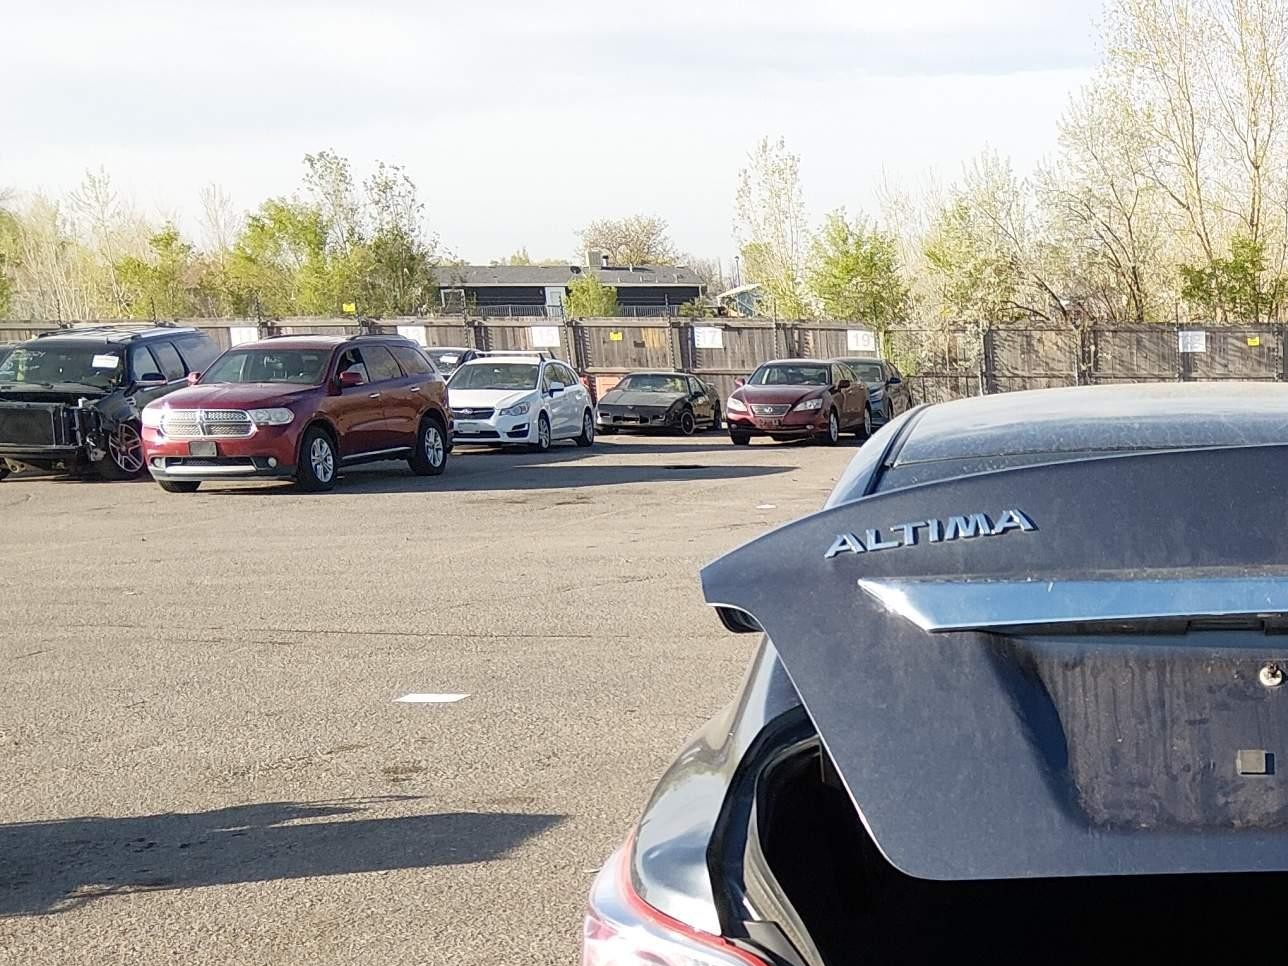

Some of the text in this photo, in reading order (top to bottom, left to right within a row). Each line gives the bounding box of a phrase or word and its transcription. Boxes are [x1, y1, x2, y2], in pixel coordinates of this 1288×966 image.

[702, 330, 717, 345] 17
[854, 333, 870, 347] 19
[824, 508, 1038, 559] ALTIMA
